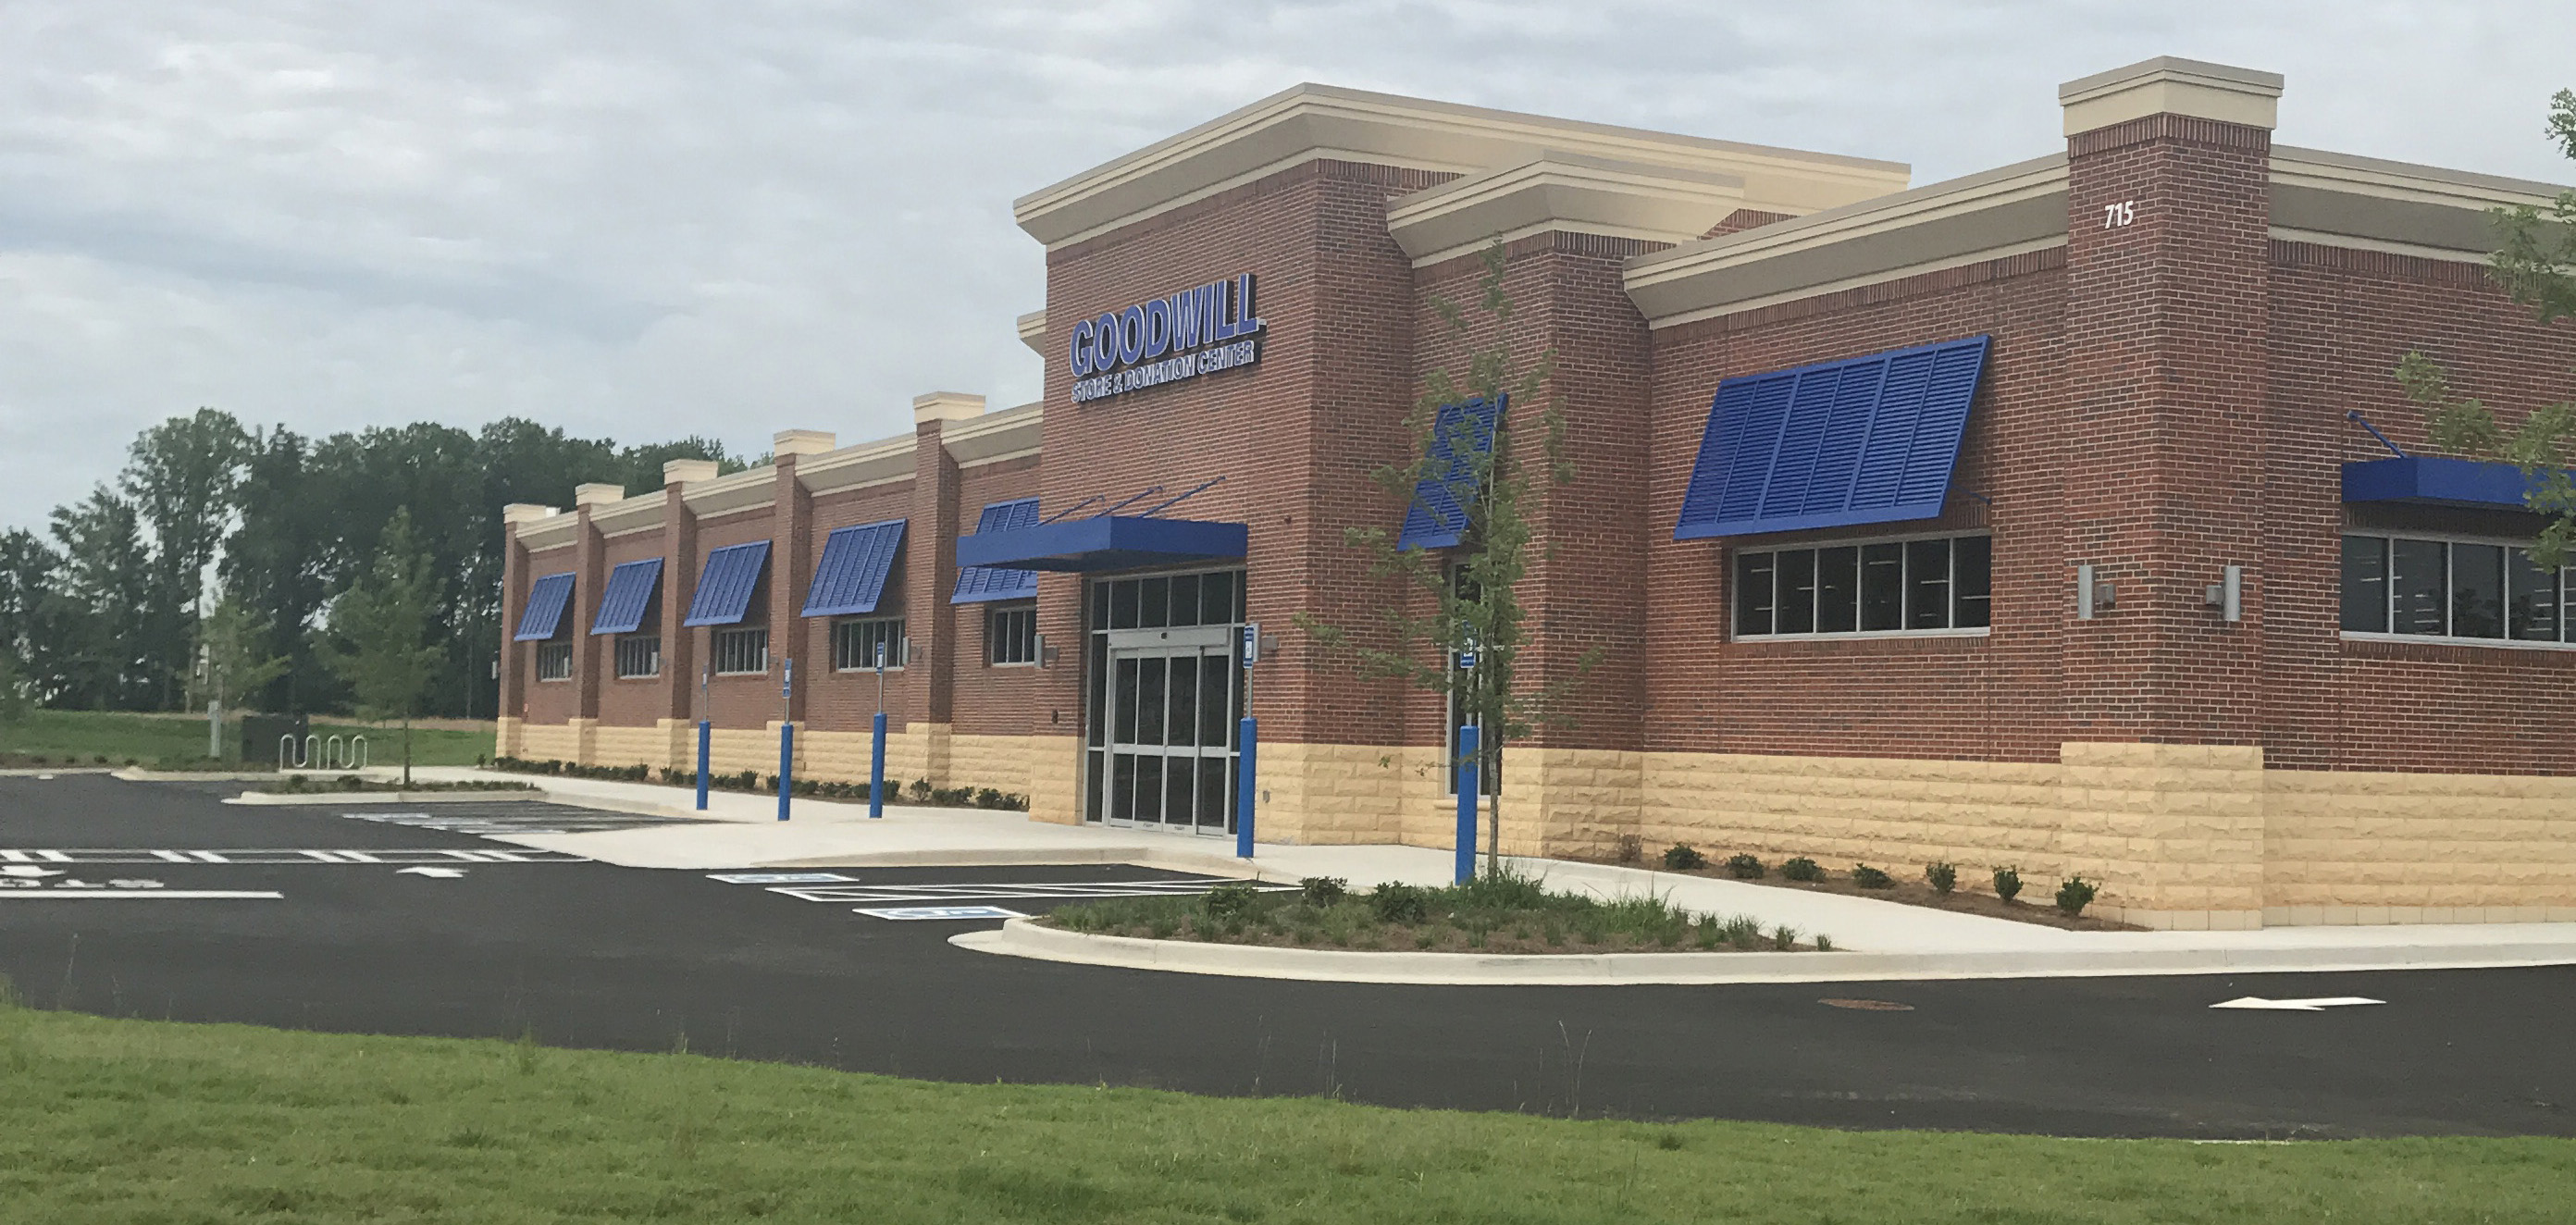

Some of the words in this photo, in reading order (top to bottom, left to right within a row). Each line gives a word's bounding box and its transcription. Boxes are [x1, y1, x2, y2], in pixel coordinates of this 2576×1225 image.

[2104, 200, 2134, 229] 715
[1070, 273, 1260, 377] GOODWILL
[1071, 374, 1111, 403] STORE
[1112, 372, 1122, 394] &
[1124, 354, 1195, 392] DONATION
[1197, 340, 1255, 375] CENTER
